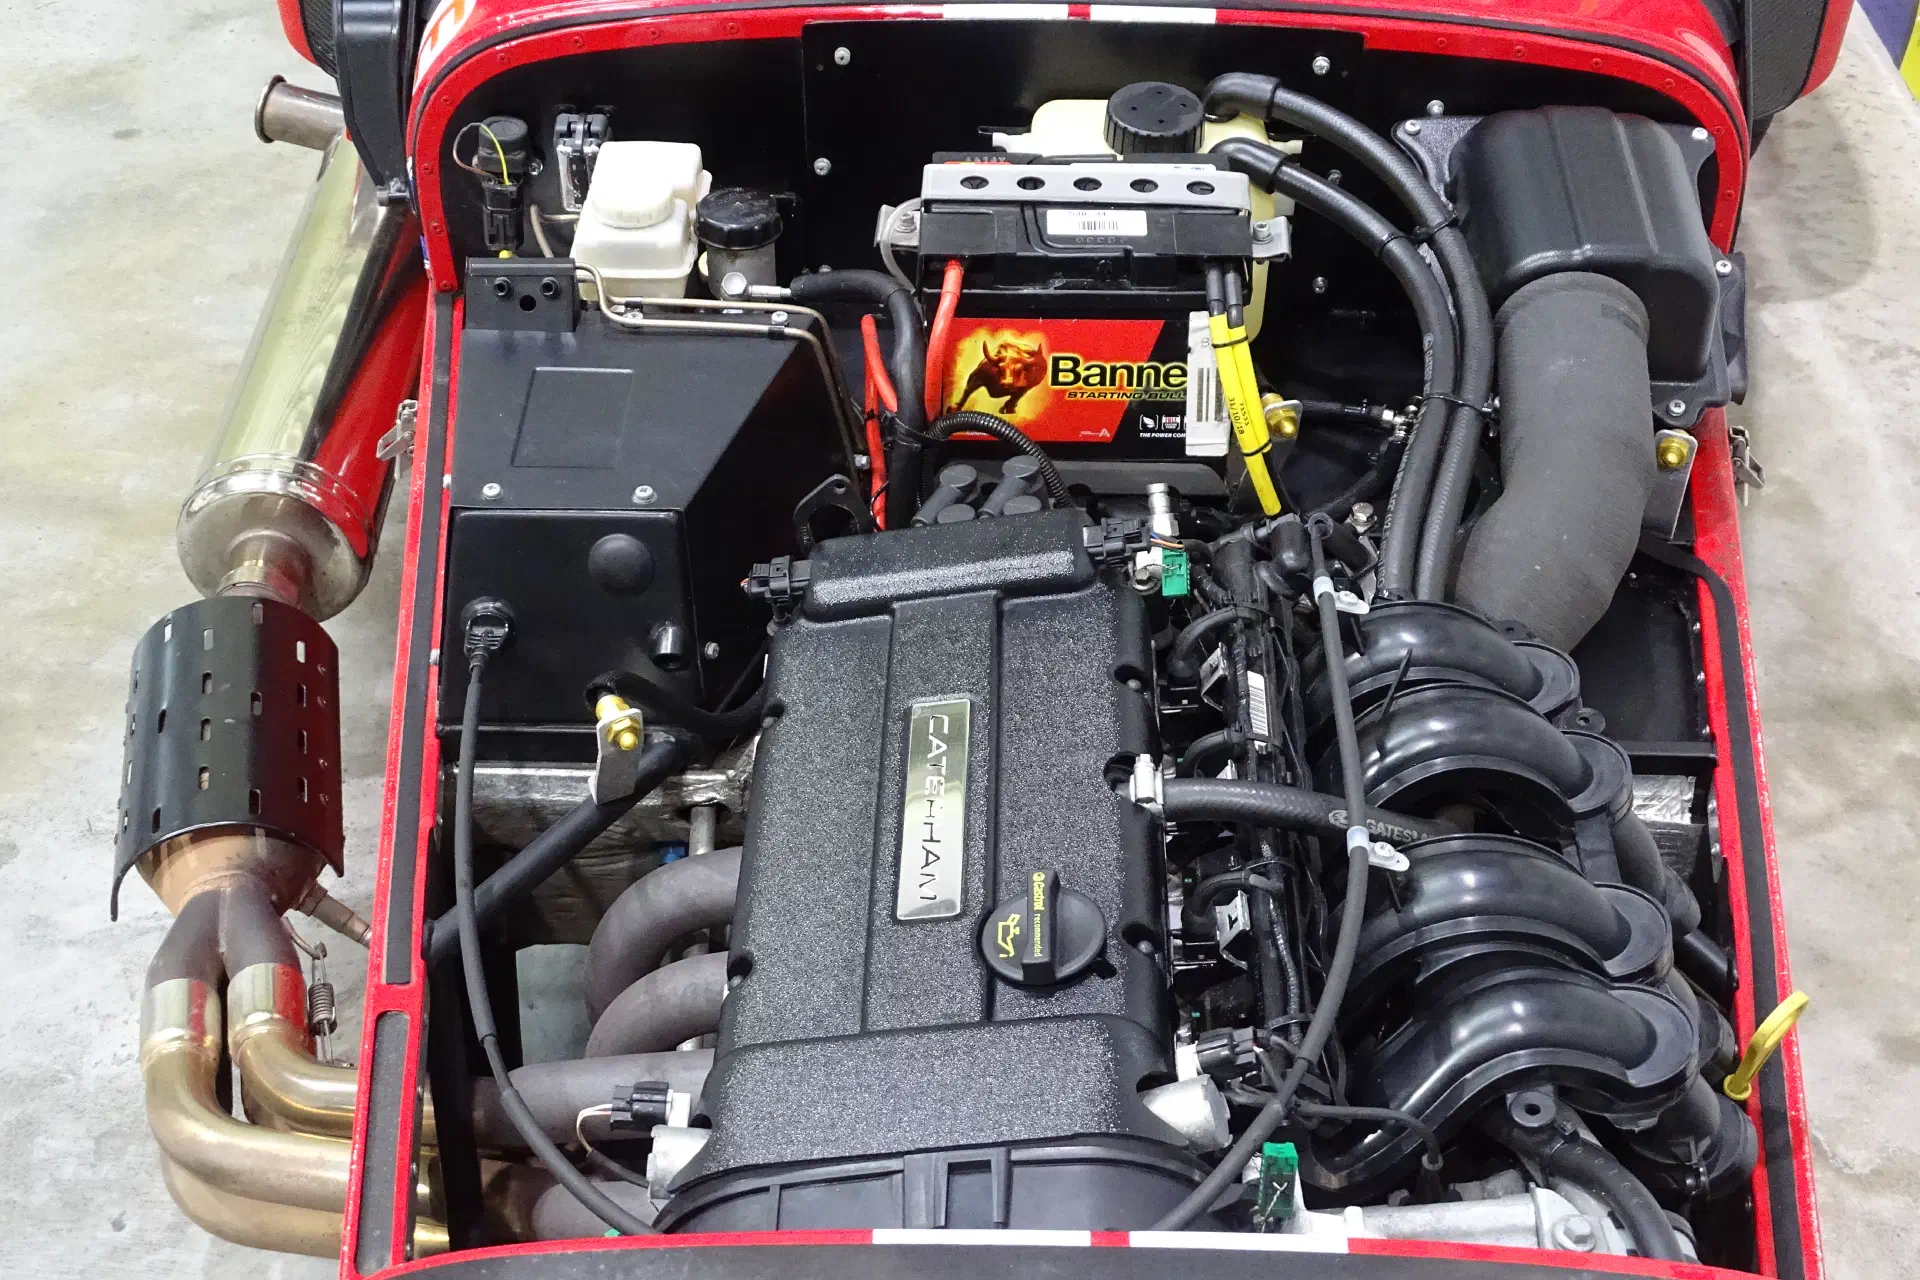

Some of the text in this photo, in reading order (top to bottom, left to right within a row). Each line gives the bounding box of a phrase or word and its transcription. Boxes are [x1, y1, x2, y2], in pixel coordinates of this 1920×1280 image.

[1050, 354, 1188, 388] Banne
[1067, 391, 1187, 400] STARTING BULL
[1228, 396, 1245, 435] 31/10/18
[1033, 881, 1045, 957] Castrol recommended
